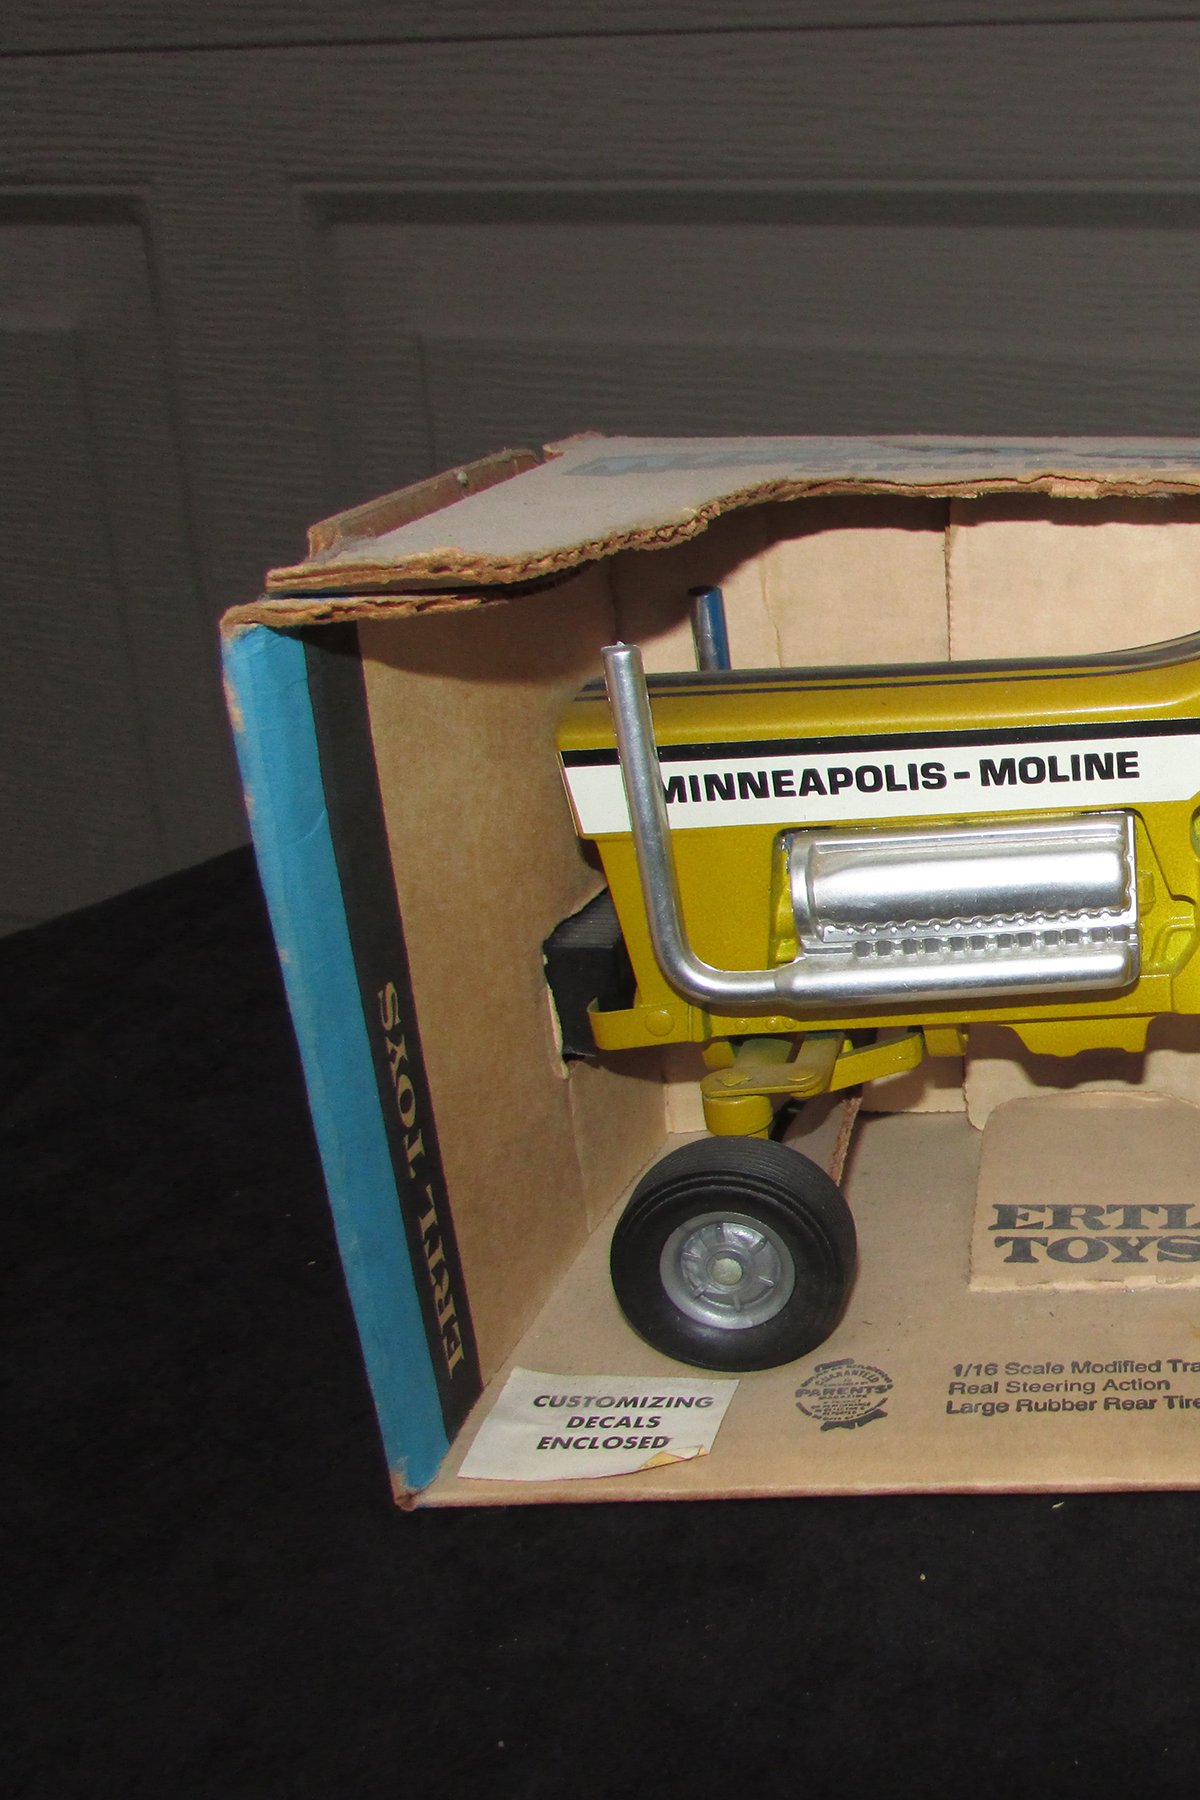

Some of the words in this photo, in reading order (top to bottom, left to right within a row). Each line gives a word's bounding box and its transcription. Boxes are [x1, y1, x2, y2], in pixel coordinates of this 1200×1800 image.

[378, 982, 426, 1179] TOYS
[419, 1184, 465, 1380] ERTL
[953, 1362, 999, 1377] 1/16
[1005, 1361, 1065, 1375] Scale
[1071, 1359, 1162, 1374] Modified
[948, 1381, 999, 1395] Real
[1006, 1379, 1096, 1395] Steering
[1102, 1378, 1171, 1391] Action
[533, 1395, 715, 1408] CUSTOMIZING
[946, 1400, 1010, 1416] Large
[1015, 1398, 1097, 1412] Rubber
[1103, 1396, 1158, 1410] Rear
[566, 1416, 661, 1429] DECALS
[536, 1436, 673, 1450] ENCLOSED
